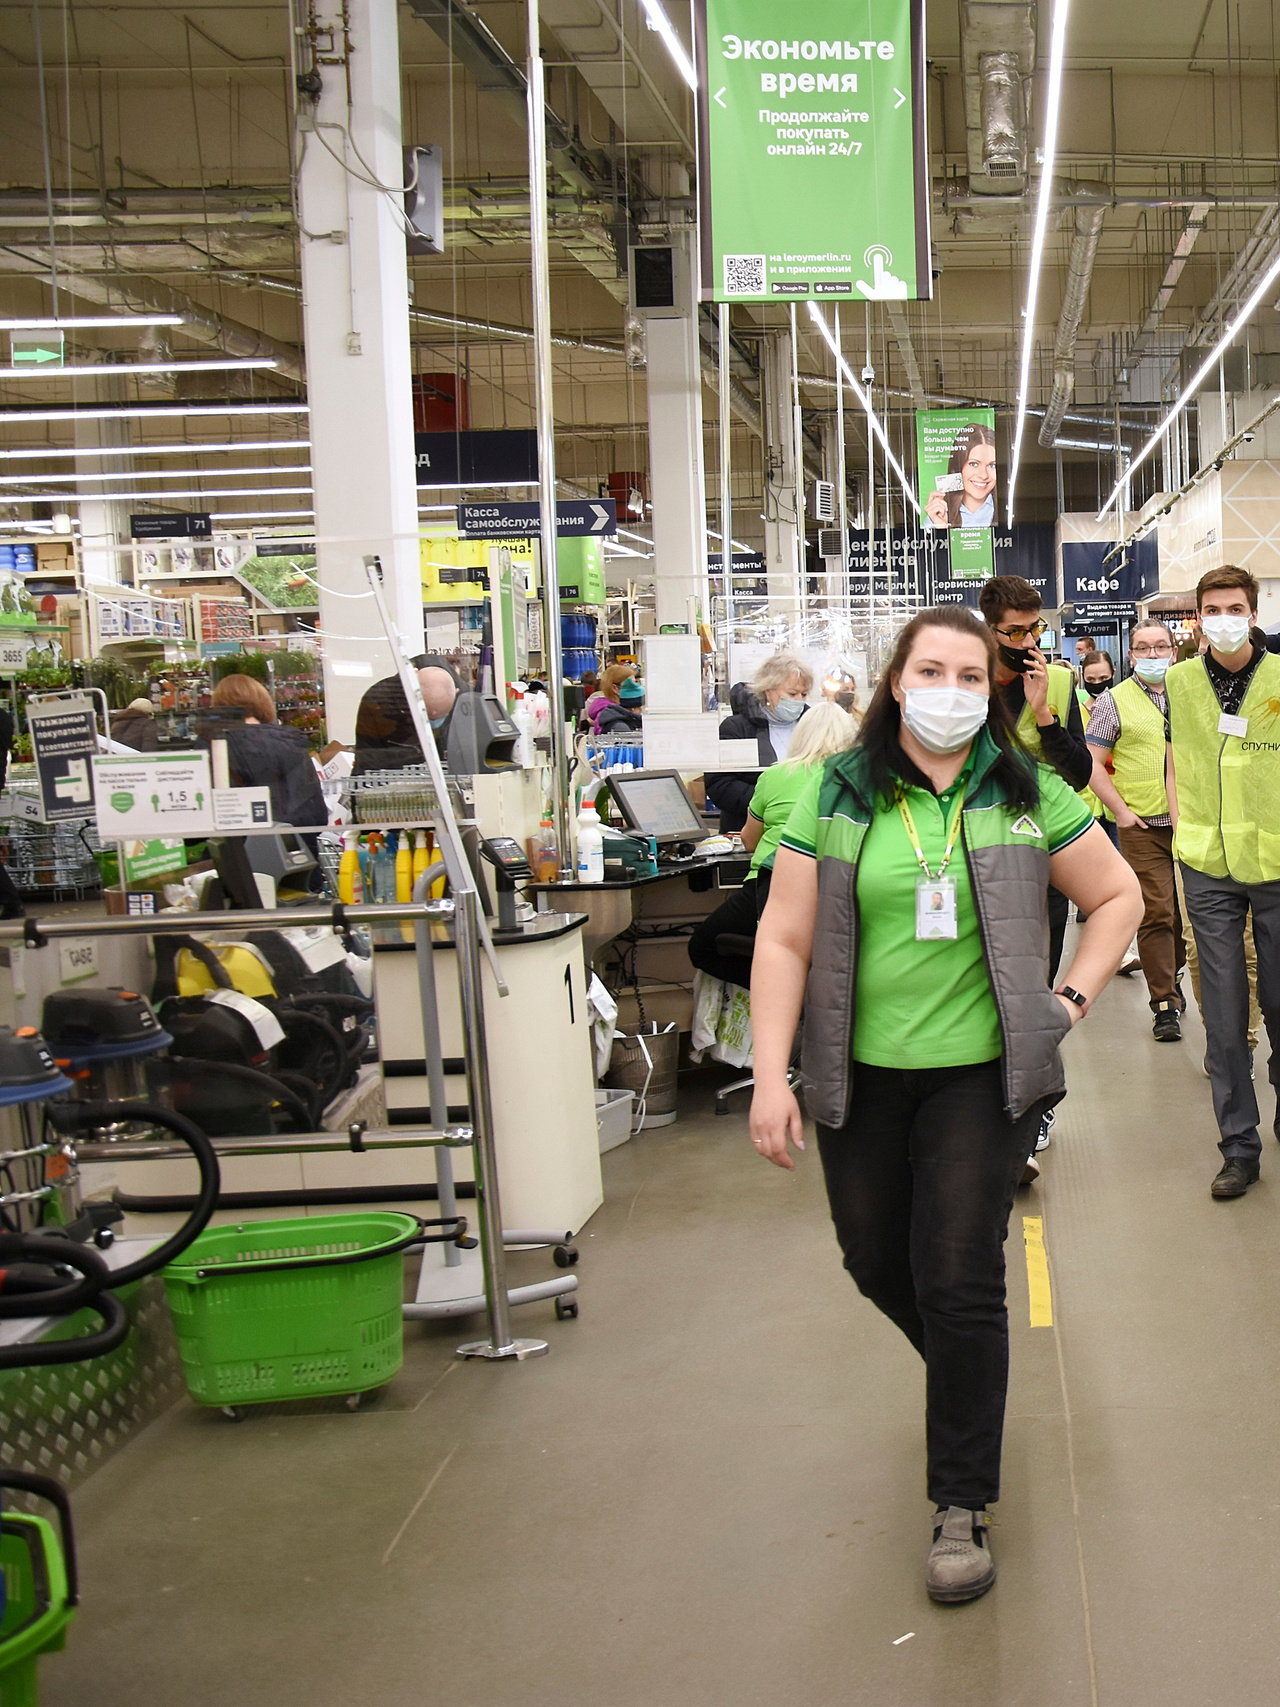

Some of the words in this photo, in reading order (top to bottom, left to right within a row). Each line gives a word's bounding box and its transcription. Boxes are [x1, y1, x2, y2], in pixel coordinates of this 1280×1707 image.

[722, 34, 895, 61] Экономьте
[760, 71, 858, 98] время
[759, 109, 869, 125] Продолжайте
[776, 127, 849, 142] покупать
[767, 141, 825, 155] онлайн
[829, 142, 862, 156] 24/7
[783, 252, 851, 264] leroymerlin.ru
[786, 265, 852, 275] приложении
[923, 427, 938, 435] Вам
[938, 427, 975, 436] доступно
[923, 435, 954, 444] больше,
[955, 435, 970, 443] чем
[935, 444, 968, 453] думаете
[465, 507, 500, 518] Касса
[194, 519, 206, 529] 71
[465, 515, 585, 531] самообслужания
[1076, 576, 1120, 597] Кафе
[1083, 624, 1110, 633] Туалет
[35, 715, 86, 727] Уважаемые
[36, 725, 90, 739] покупатели!
[168, 790, 187, 803] 1,5
[25, 805, 38, 816] 54
[564, 963, 575, 1024] 1
